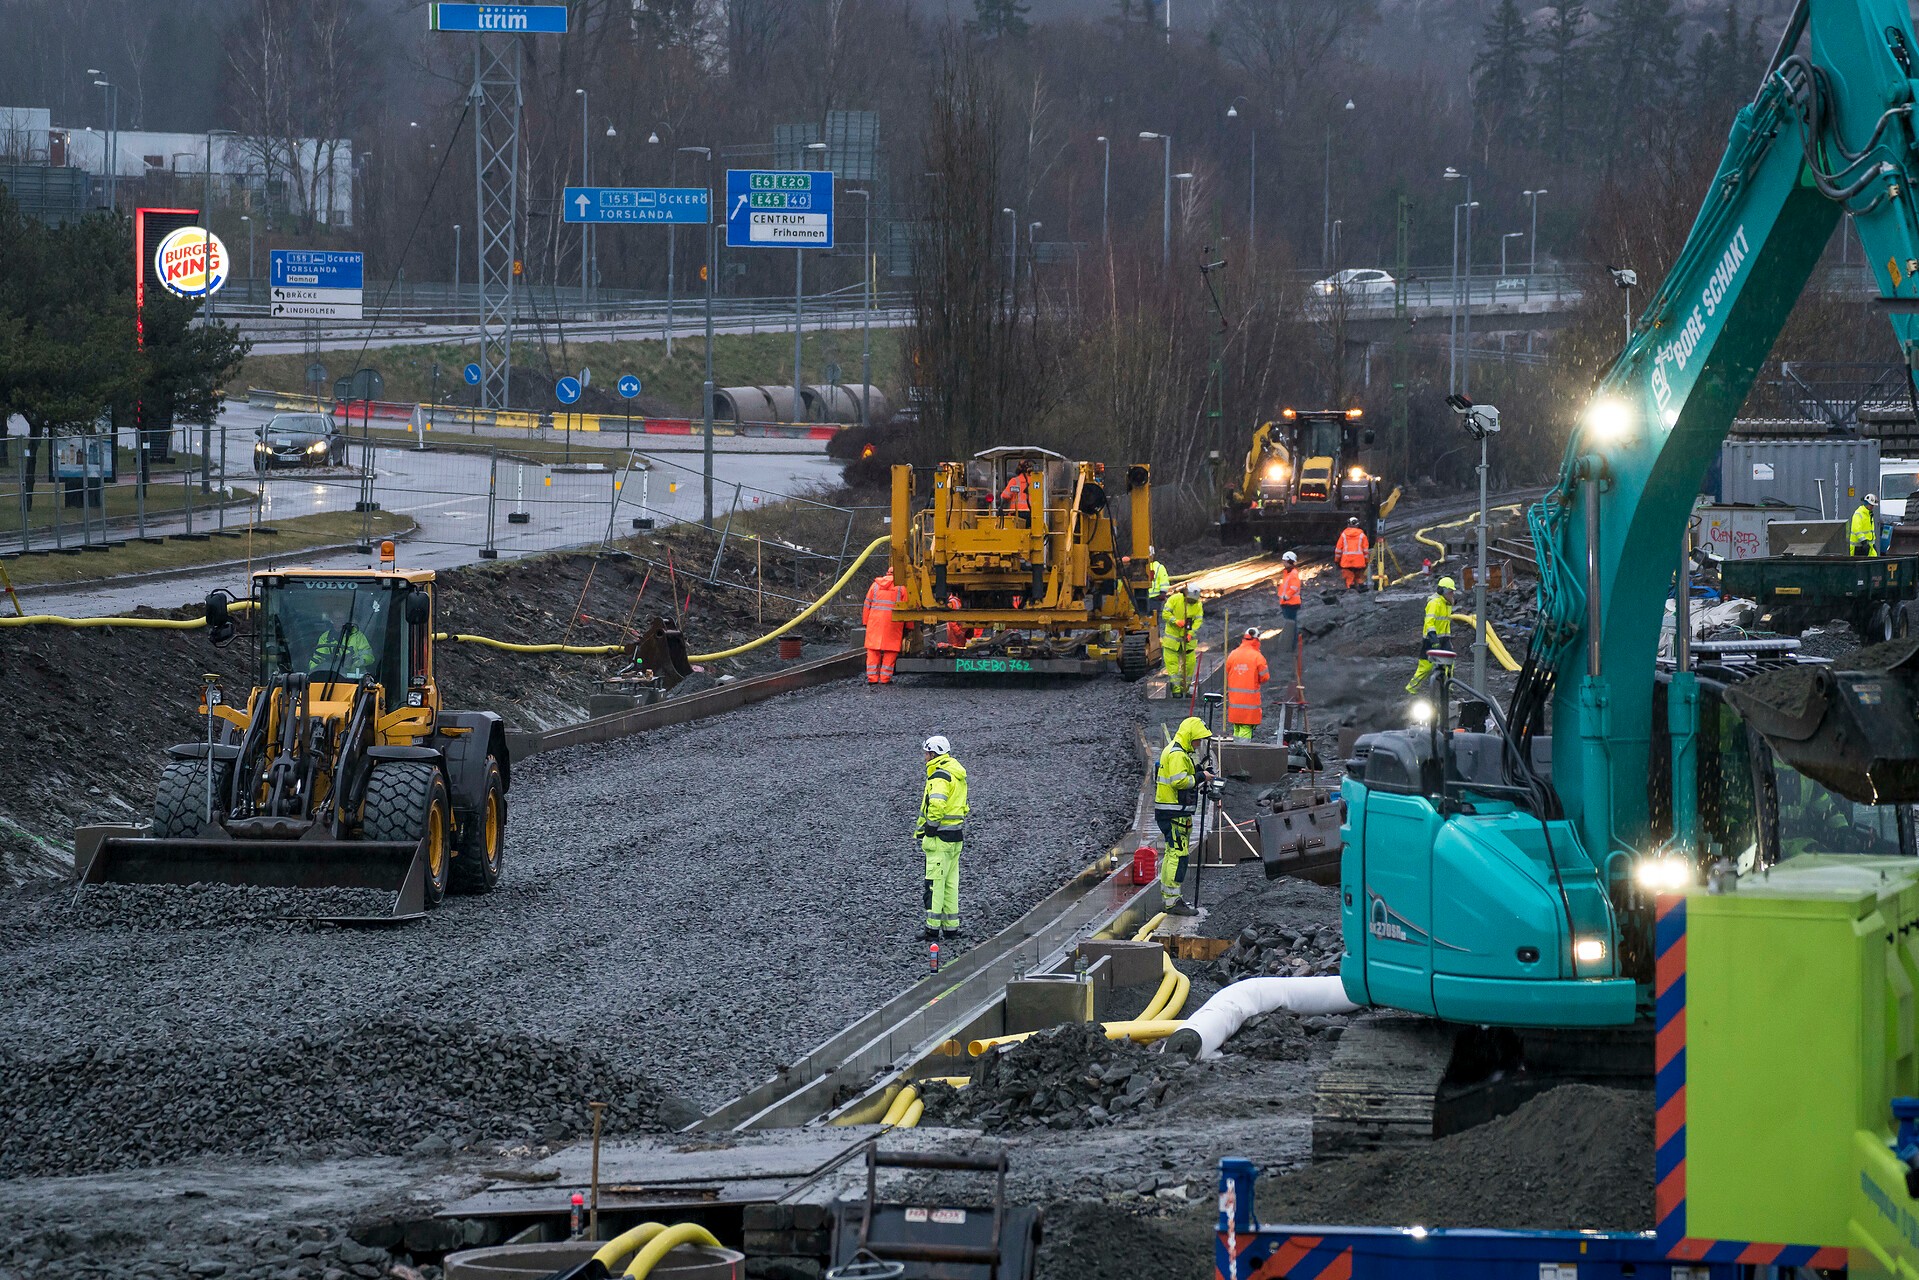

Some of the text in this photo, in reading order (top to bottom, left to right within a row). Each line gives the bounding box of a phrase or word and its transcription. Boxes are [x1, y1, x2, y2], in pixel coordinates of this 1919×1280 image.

[756, 177, 804, 187] E6 E20
[609, 193, 707, 204] 155 ÖCKERÖ
[757, 195, 807, 206] E45 40
[600, 210, 673, 219] TORSLANDA
[753, 214, 805, 224] CENTRUM
[773, 228, 825, 238] Frihamnen
[165, 242, 217, 264] BURGER
[327, 254, 361, 263] ÖCKERÖ
[168, 254, 219, 281] KING
[286, 265, 337, 273] TORSLANDA
[286, 290, 317, 299] BRÄCKE
[1673, 224, 1749, 371] BORE SCHAKT
[286, 307, 336, 315] LINDHOLMEN
[304, 581, 358, 589] VOLVO
